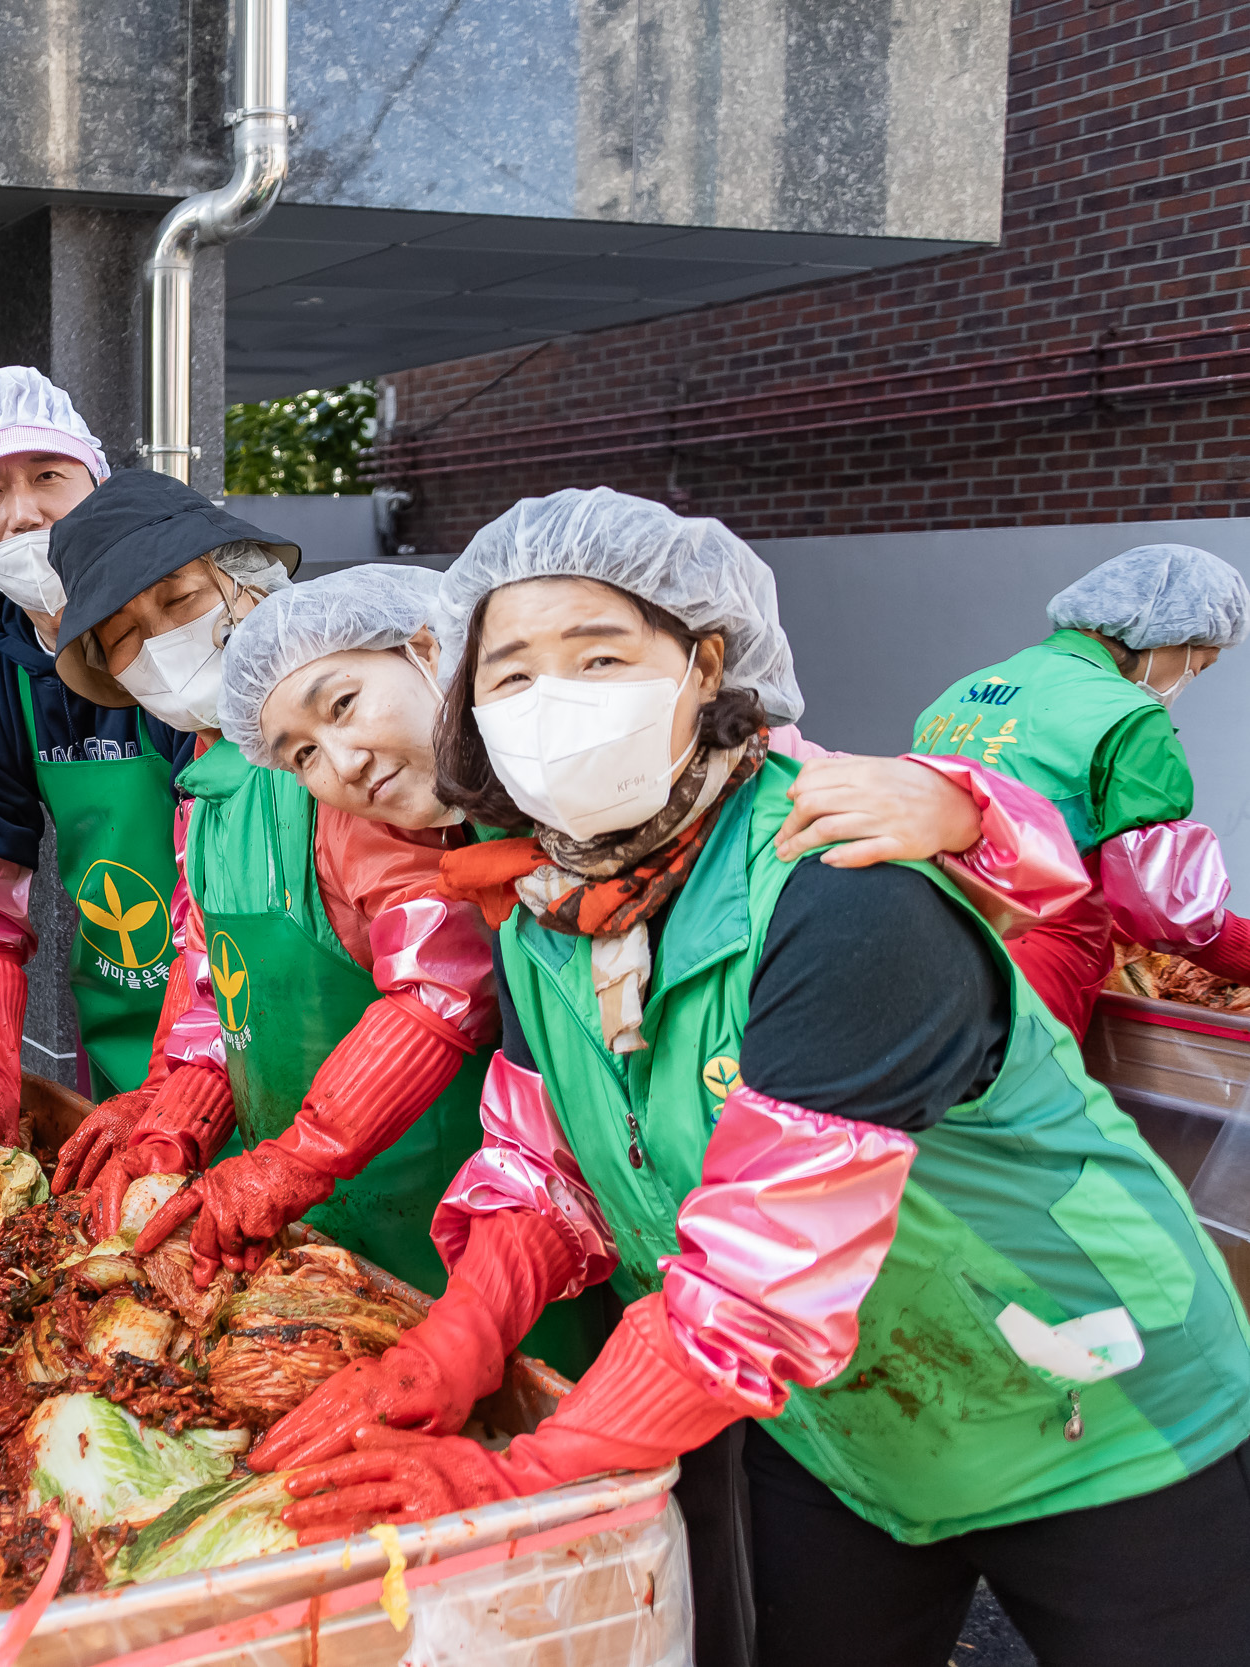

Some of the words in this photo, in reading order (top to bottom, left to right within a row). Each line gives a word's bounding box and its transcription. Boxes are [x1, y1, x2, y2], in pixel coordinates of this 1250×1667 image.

[959, 682, 1023, 706] SMU
[913, 711, 1019, 765] 새마을
[616, 774, 646, 793] KF-94
[95, 956, 170, 990] 새마을운동
